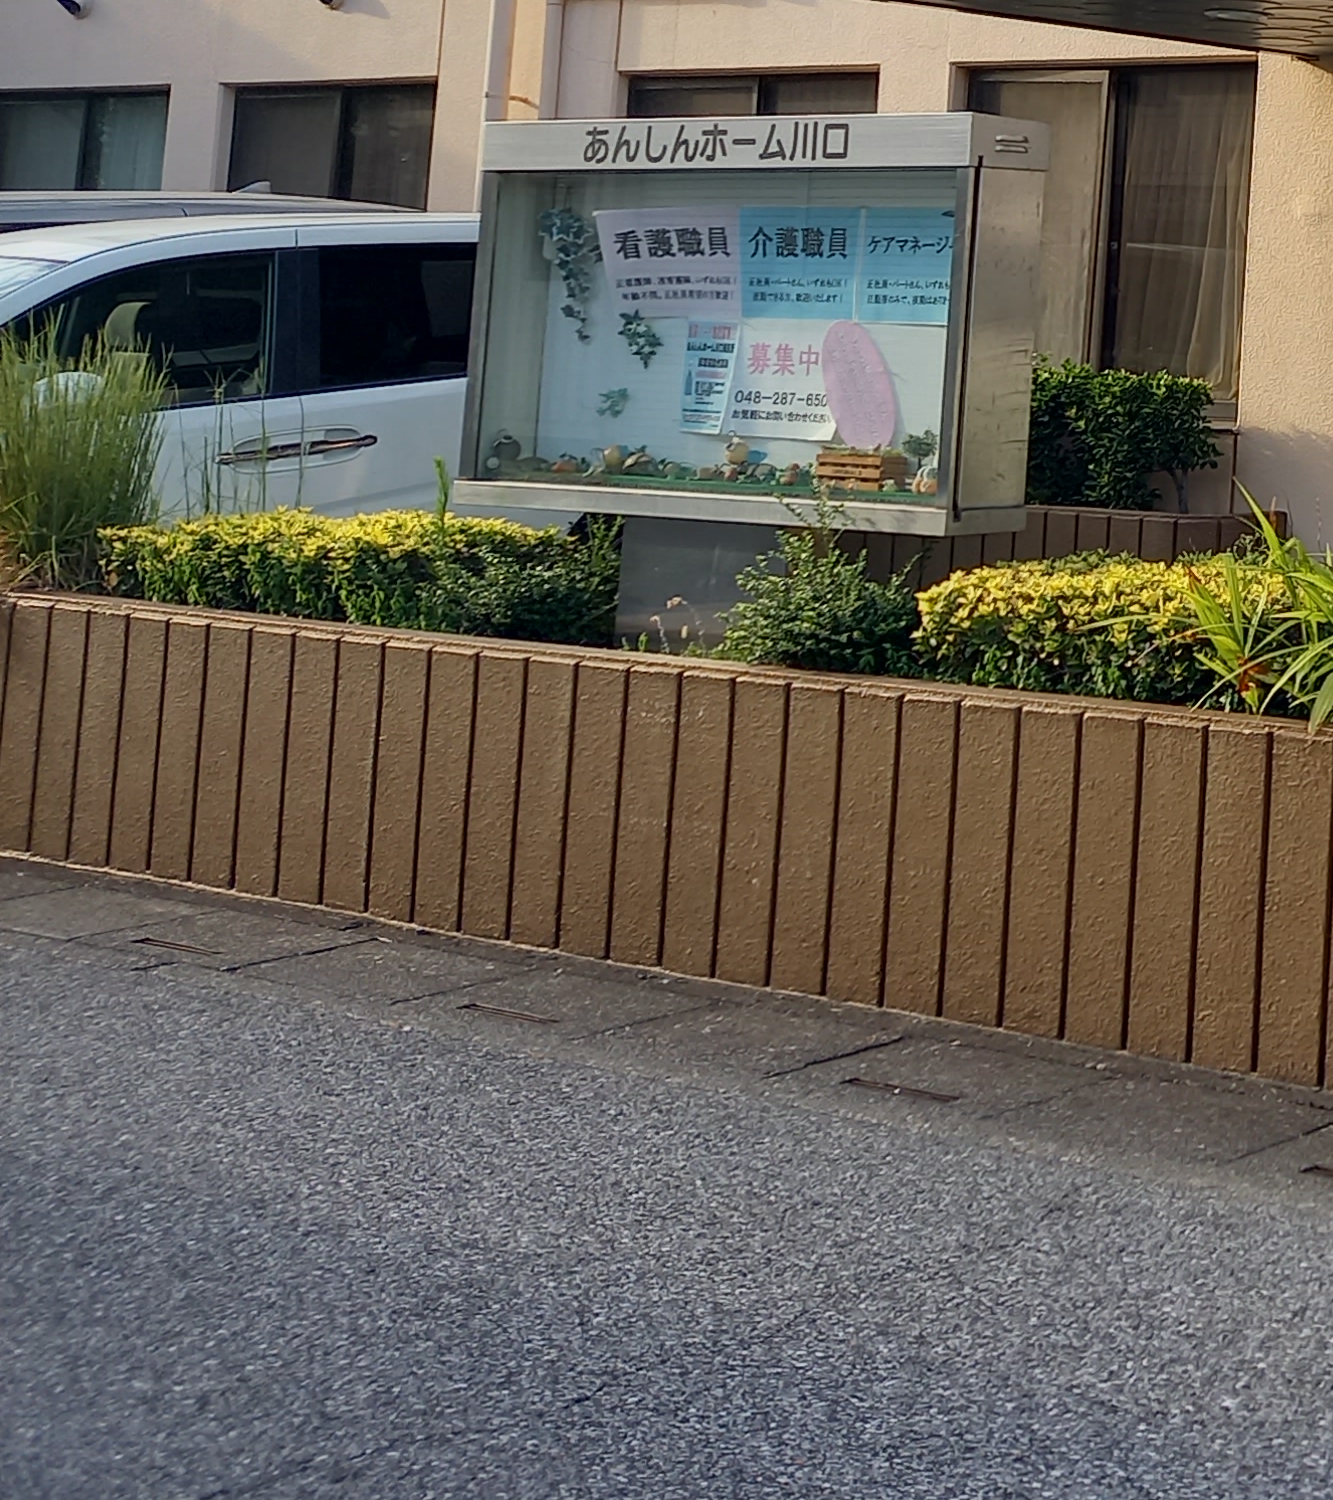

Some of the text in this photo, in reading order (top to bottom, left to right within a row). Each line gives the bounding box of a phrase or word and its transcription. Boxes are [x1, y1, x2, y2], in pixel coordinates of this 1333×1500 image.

[583, 121, 850, 164] あんしんホーム川口
[613, 227, 732, 260] 看護職員
[748, 227, 849, 260] 介護職員
[747, 342, 821, 377] 募集中
